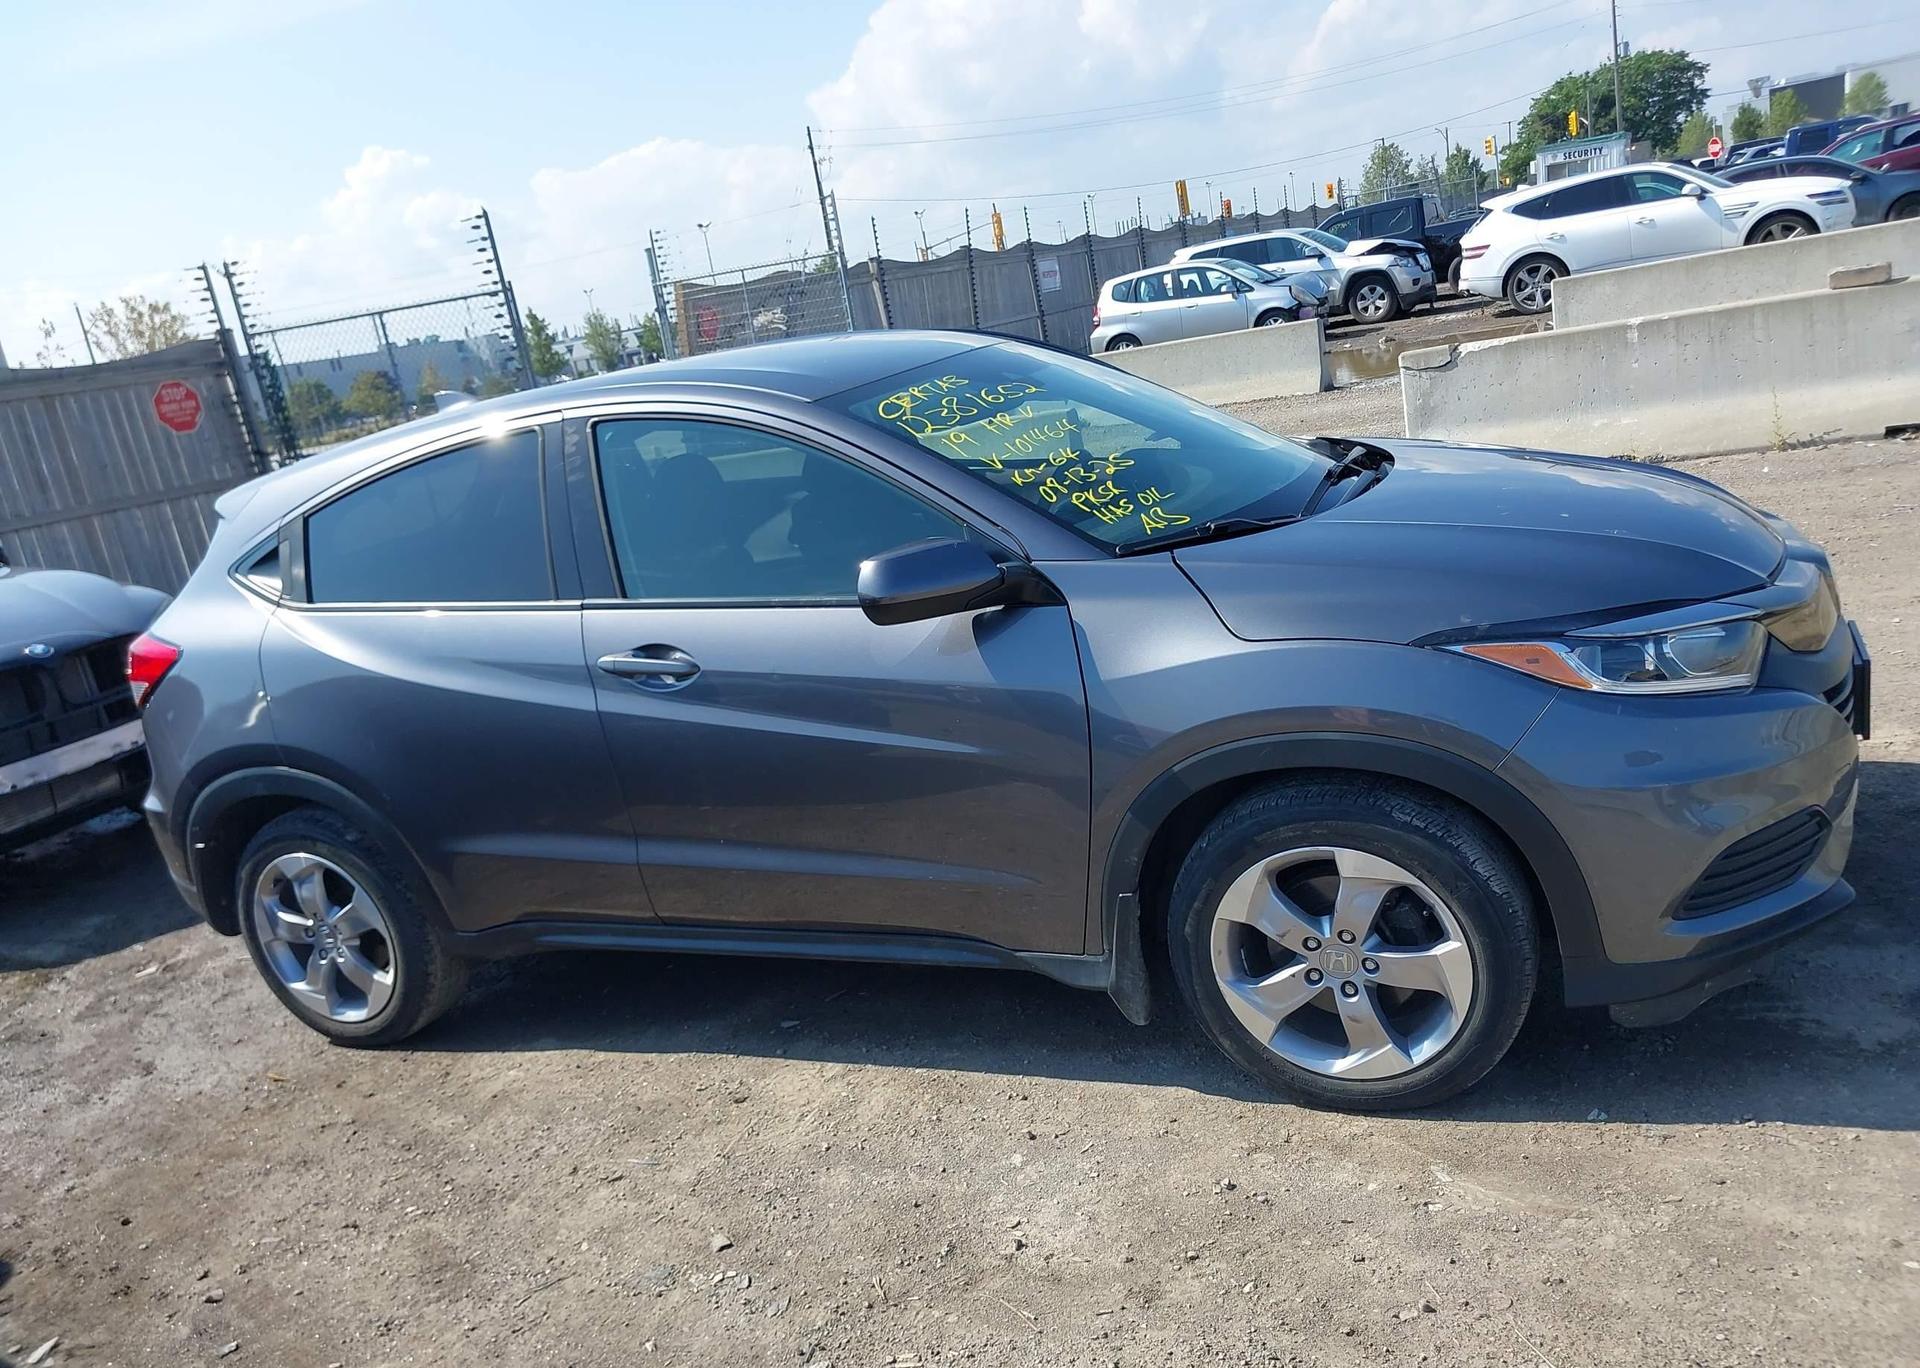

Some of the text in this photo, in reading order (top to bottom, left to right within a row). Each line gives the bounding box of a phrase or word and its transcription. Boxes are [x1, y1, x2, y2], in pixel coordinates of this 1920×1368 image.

[1563, 146, 1604, 161] SECURITY
[161, 387, 186, 403] STOP
[1093, 499, 1134, 525] HAS
